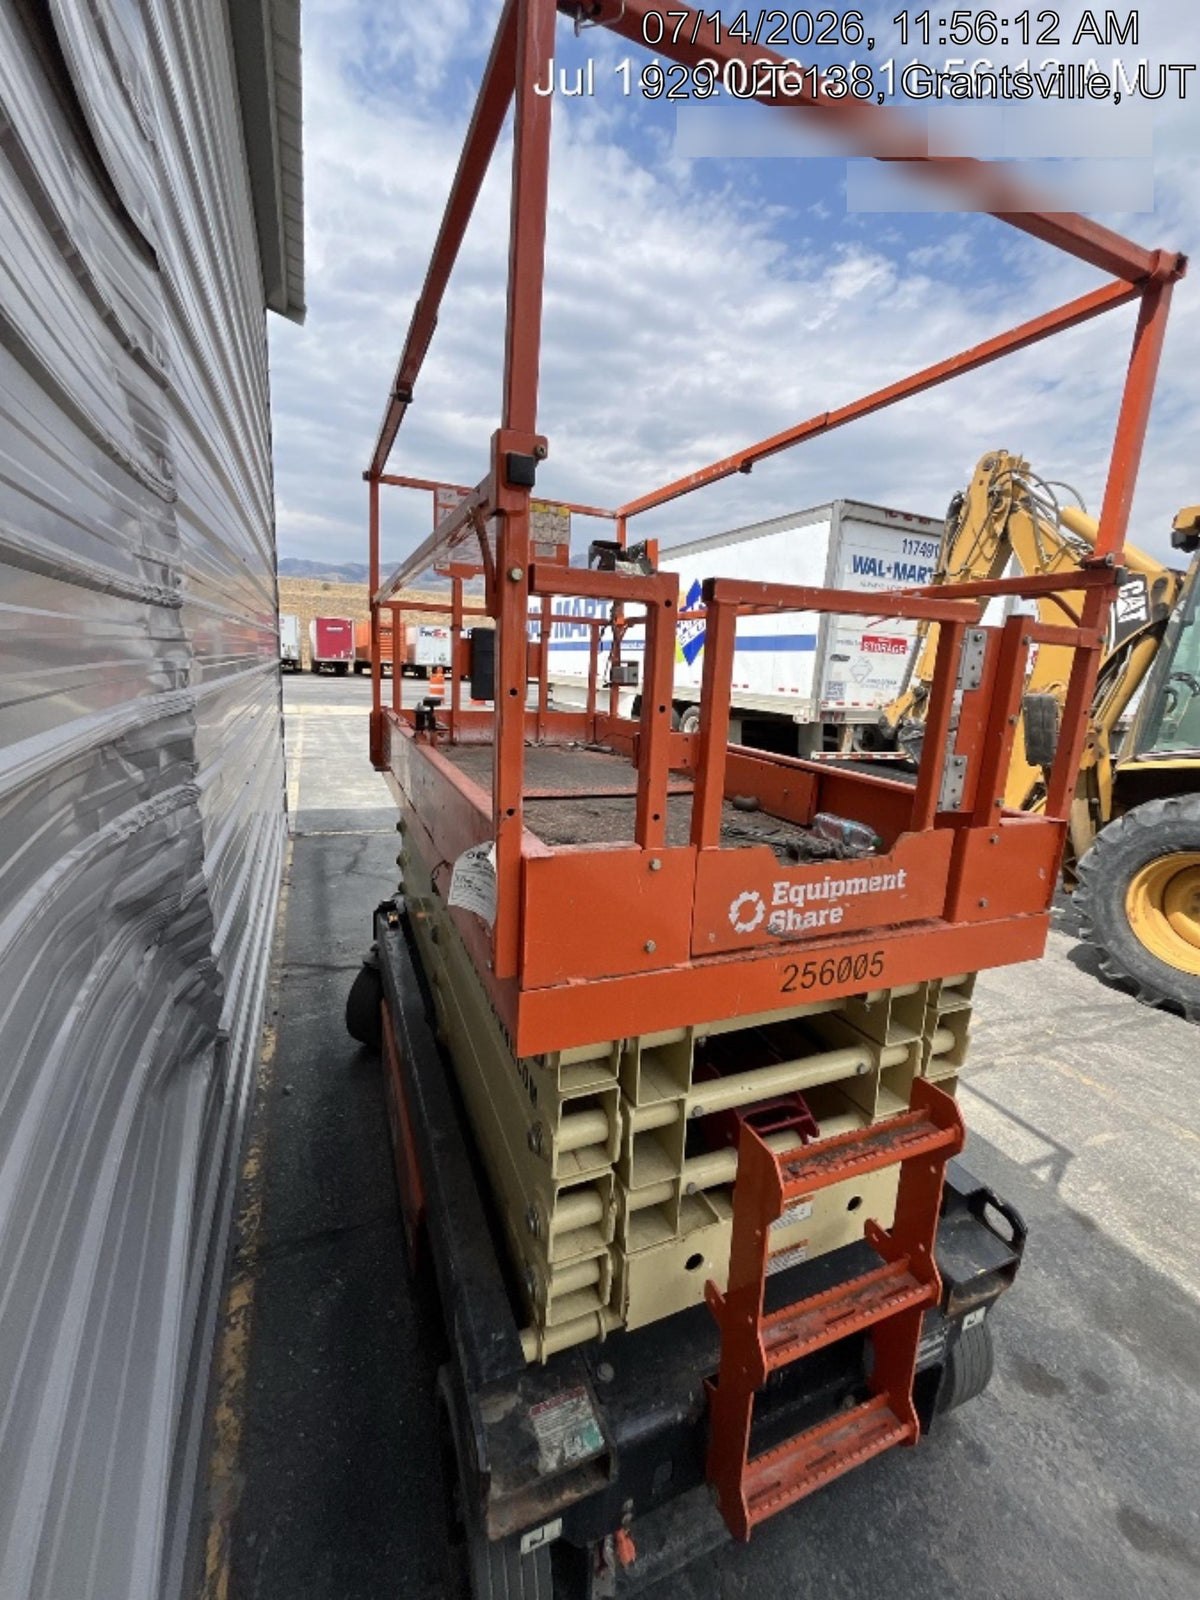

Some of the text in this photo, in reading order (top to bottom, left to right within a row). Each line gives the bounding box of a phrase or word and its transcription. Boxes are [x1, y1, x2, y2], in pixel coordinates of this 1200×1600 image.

[1117, 580, 1147, 623] CAT
[863, 641, 906, 654] STORAGE
[771, 868, 907, 907] Equipment
[768, 906, 844, 935] Share
[780, 950, 885, 993] 256005
